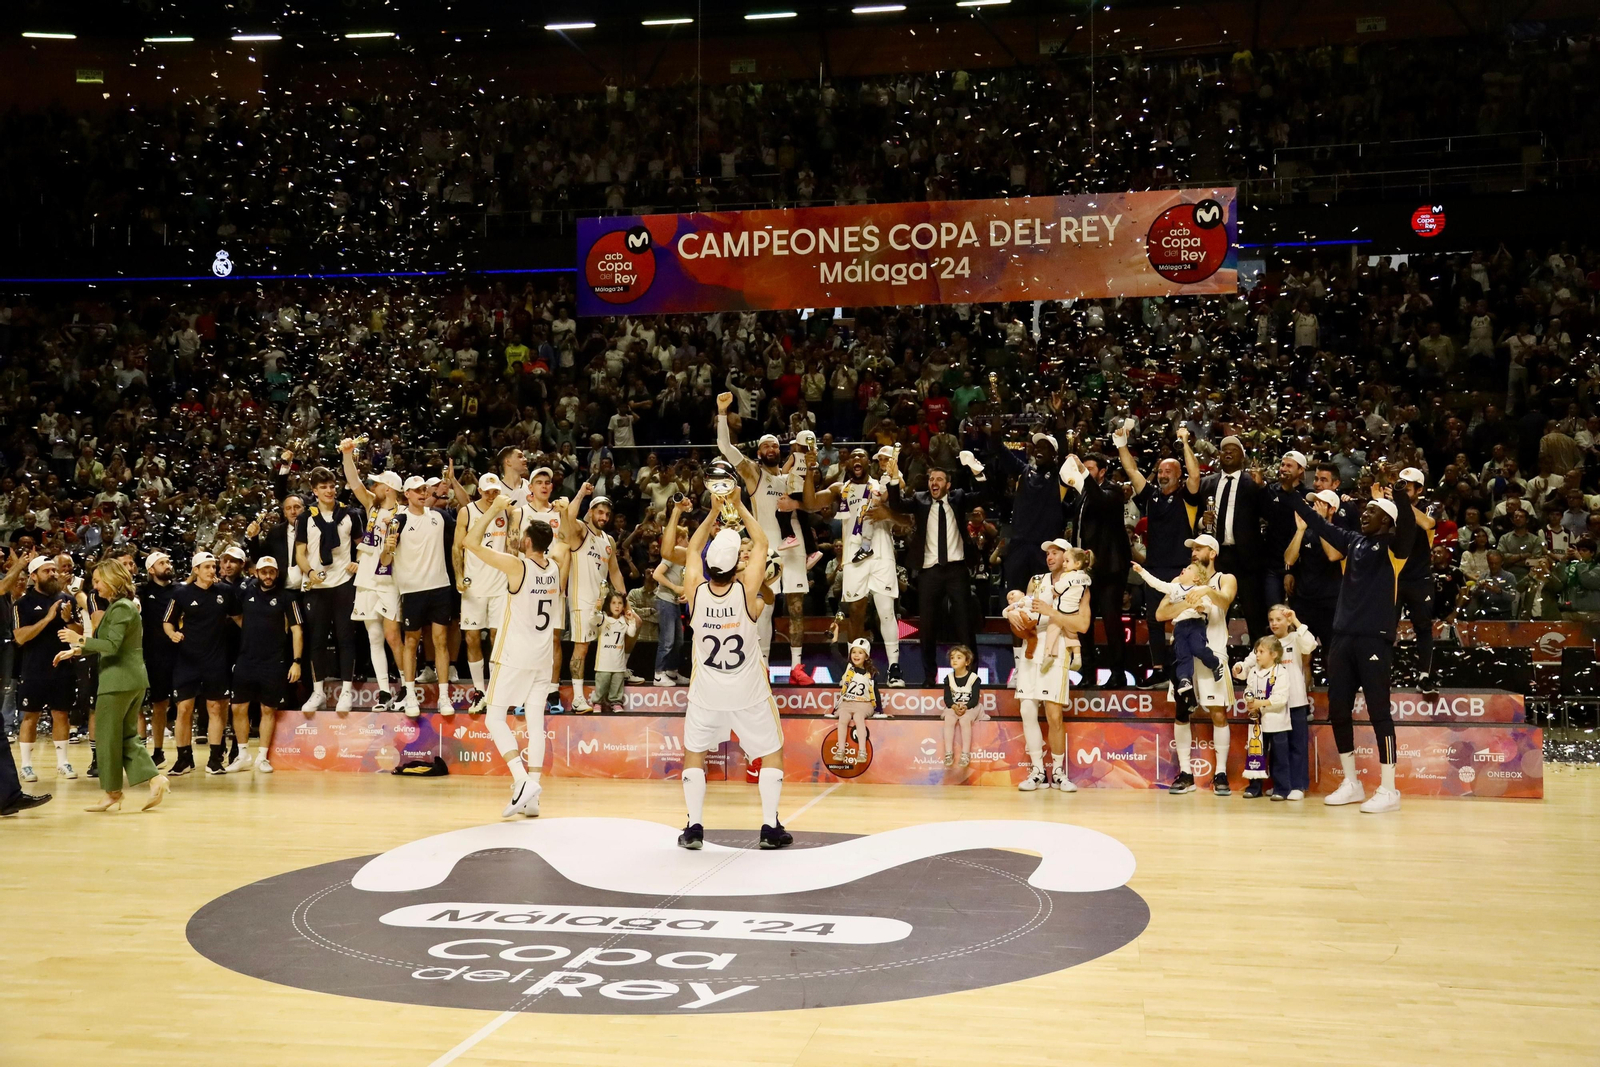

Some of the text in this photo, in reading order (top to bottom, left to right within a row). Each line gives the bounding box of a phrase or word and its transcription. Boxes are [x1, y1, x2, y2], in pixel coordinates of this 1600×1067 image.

[677, 214, 1123, 260] CAMPEONES COPA DEL REY
[1169, 227, 1191, 236] acb
[1161, 236, 1201, 249] Copa
[604, 252, 623, 261] acb
[1164, 249, 1207, 263] del Rey
[597, 260, 633, 272] Copa
[819, 259, 928, 285] Málaga
[614, 273, 638, 285] Rey
[535, 575, 556, 586] RUDY
[535, 599, 552, 632] 5
[705, 606, 737, 619] LLULL
[702, 621, 741, 630] AUTOHERO
[613, 631, 621, 645] 7
[702, 634, 746, 670] 23
[847, 680, 866, 696] 23
[603, 742, 638, 751] Movistar
[1432, 746, 1457, 756] renfe
[459, 751, 492, 763] IONOS
[970, 749, 1006, 760] málaga
[1106, 751, 1148, 761] Movistar
[1473, 754, 1505, 762] LOTUS
[1487, 770, 1523, 779] ONEBOX
[426, 908, 721, 933] Málaga
[426, 938, 740, 971] Copa
[410, 966, 761, 1009] del Rey
